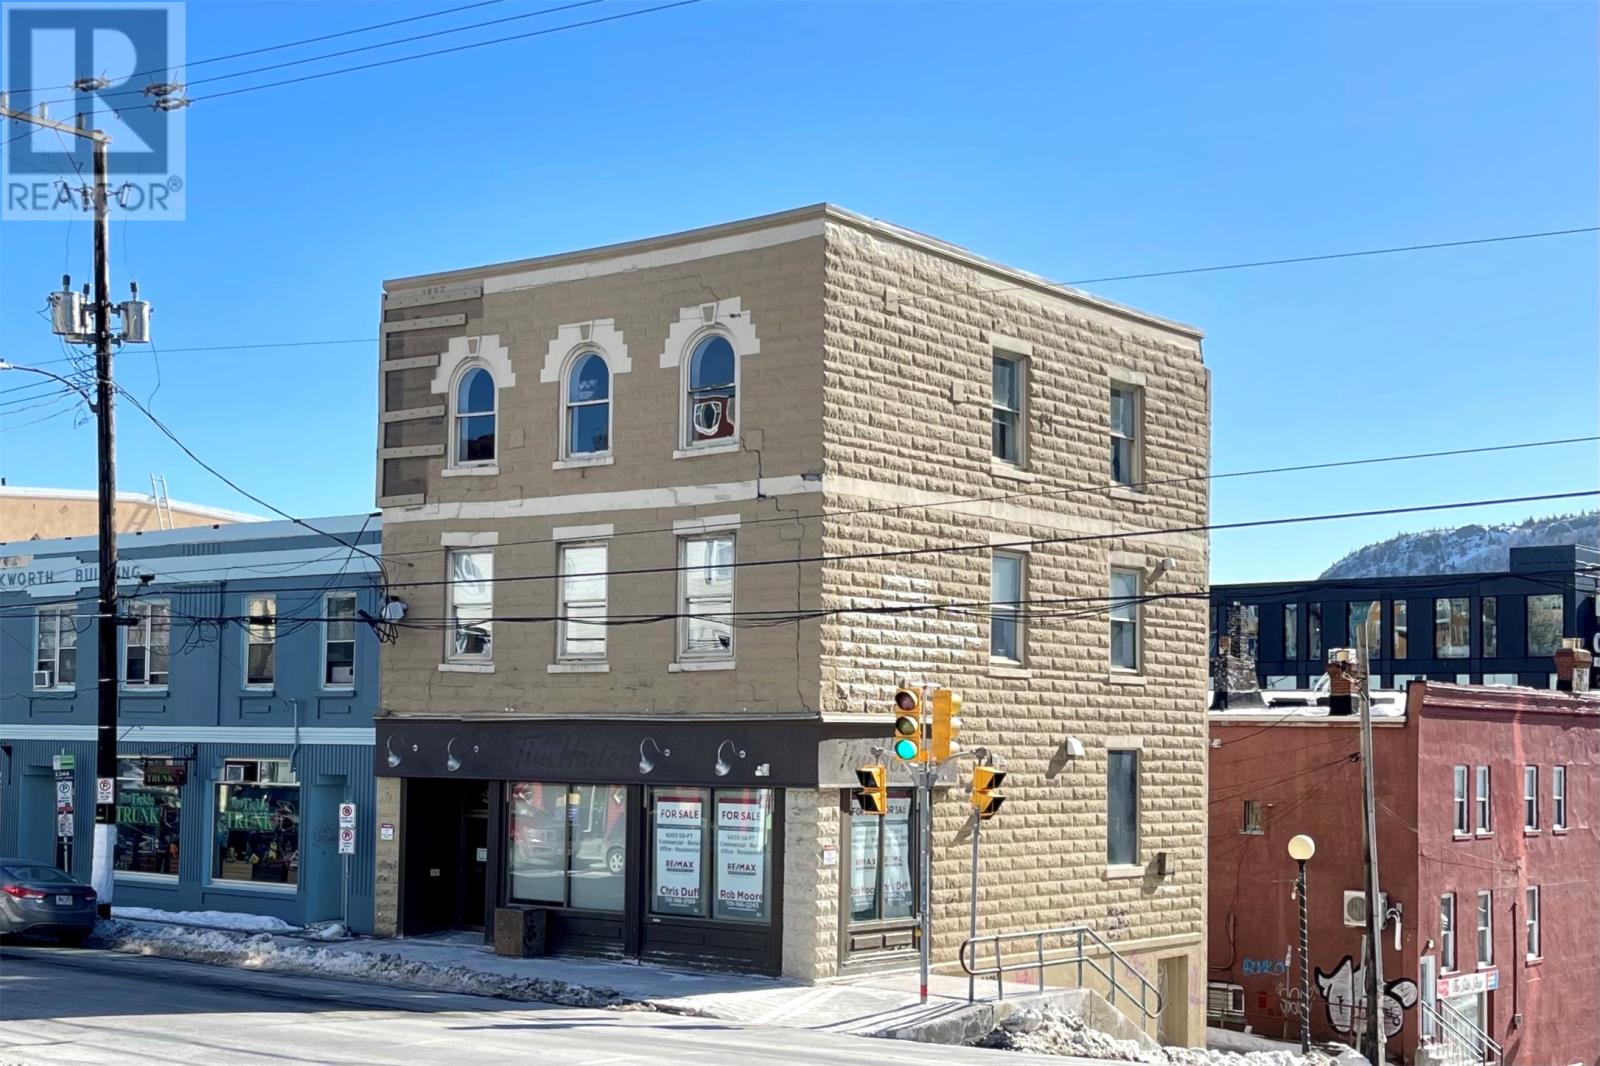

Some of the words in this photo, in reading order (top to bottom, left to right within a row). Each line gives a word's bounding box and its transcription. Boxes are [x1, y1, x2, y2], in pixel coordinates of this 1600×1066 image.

[115, 806, 160, 824] TRUNK
[660, 809, 676, 819] FOR
[678, 809, 699, 820] SALE
[722, 811, 739, 820] FOR
[741, 811, 761, 821] SALE
[225, 811, 273, 831] TRUNK
[665, 860, 694, 868] RE/MAX
[727, 863, 756, 872] RE/MAX
[660, 885, 679, 896] Chris
[720, 889, 735, 899] Rob
[737, 890, 763, 901] Moore
